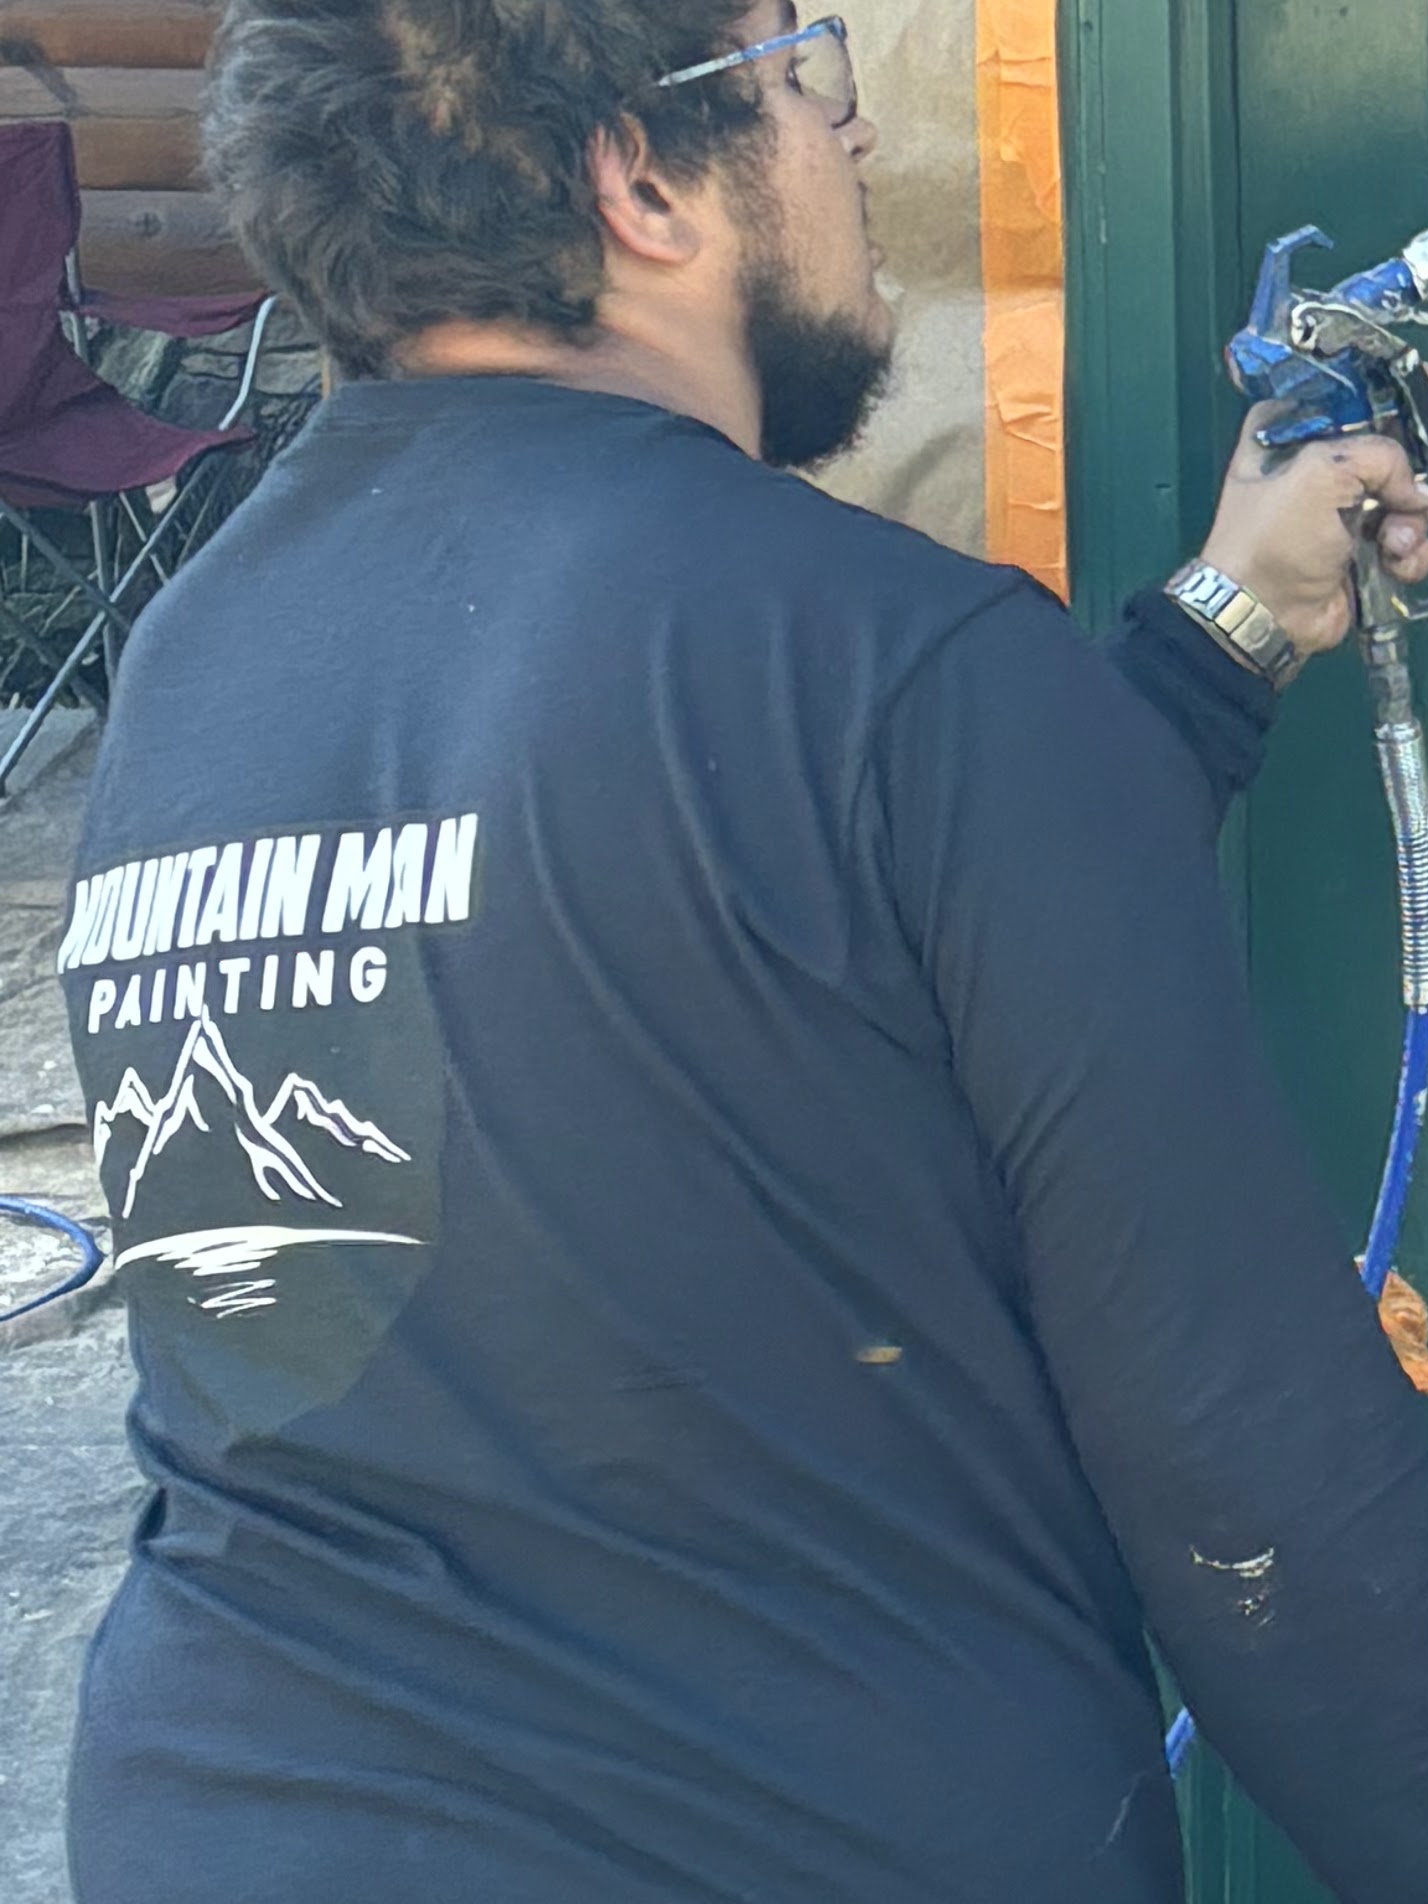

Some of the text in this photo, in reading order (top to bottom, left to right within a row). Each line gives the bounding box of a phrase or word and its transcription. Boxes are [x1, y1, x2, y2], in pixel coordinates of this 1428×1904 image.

[57, 813, 478, 974] MOUNTAIN MAN
[88, 946, 387, 1034] PAINTING
